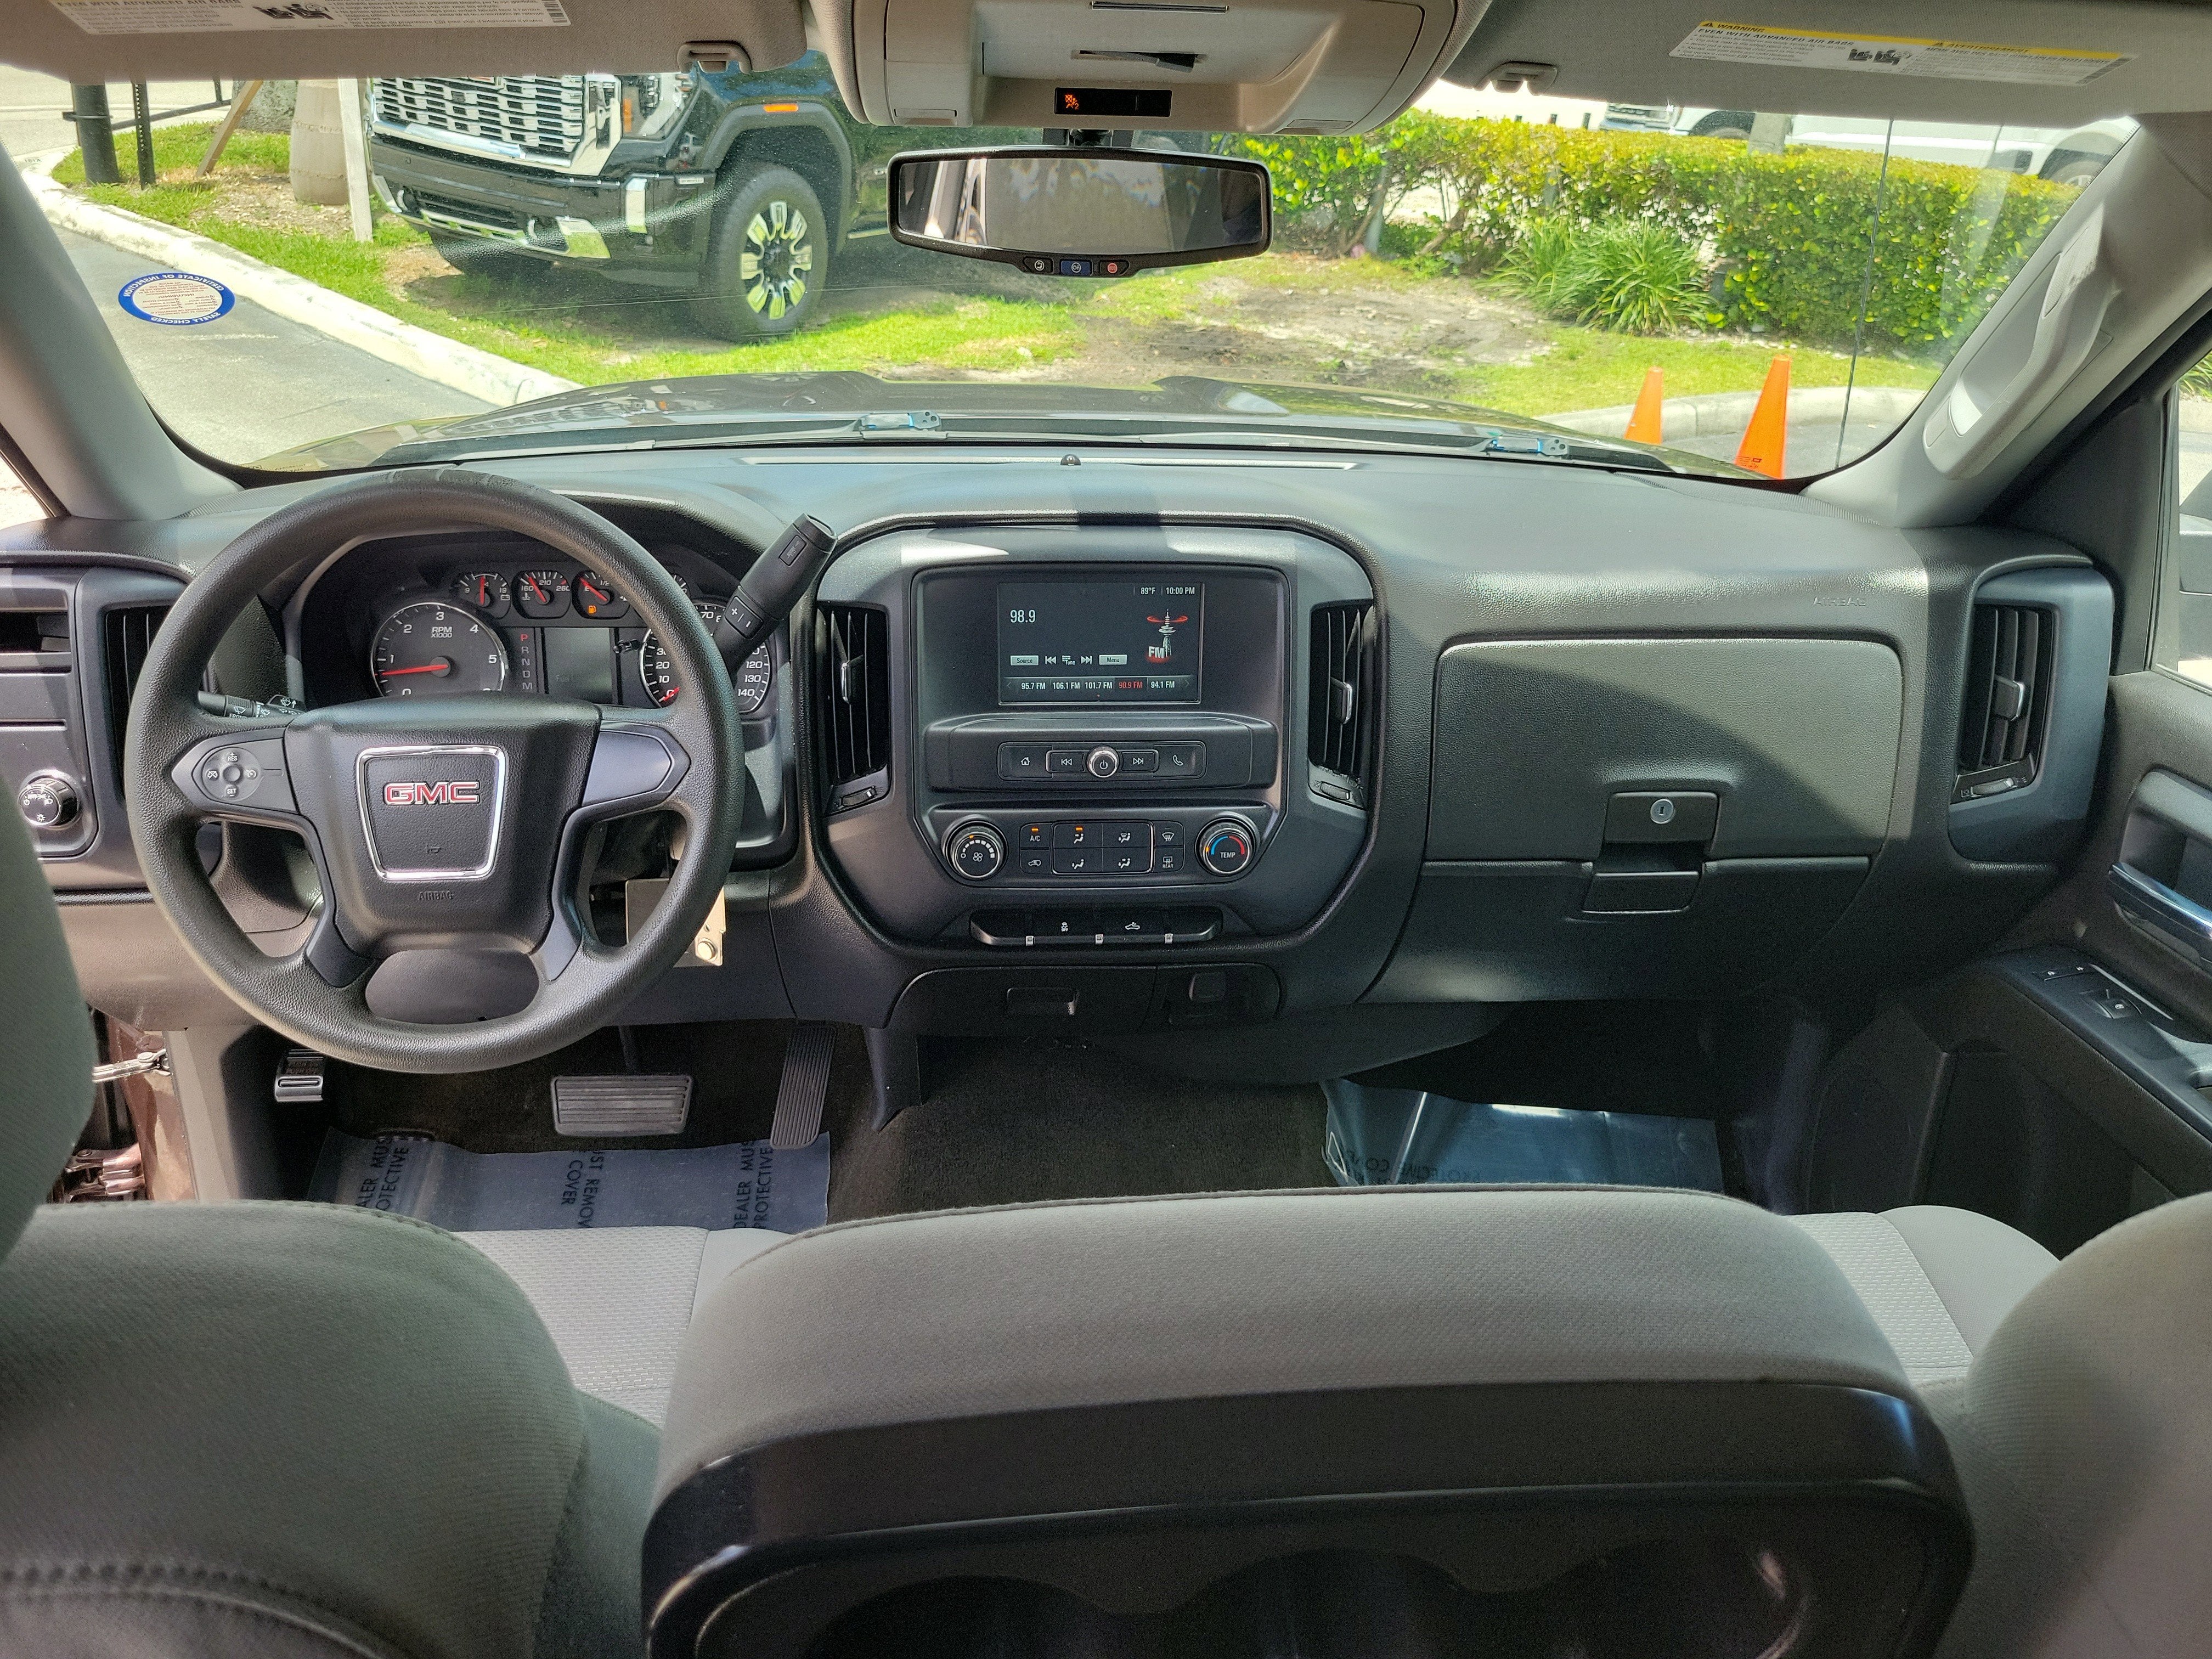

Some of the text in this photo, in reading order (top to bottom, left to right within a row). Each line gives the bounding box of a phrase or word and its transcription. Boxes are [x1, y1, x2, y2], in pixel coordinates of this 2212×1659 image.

[1717, 24, 1765, 33] WARNING
[1753, 33, 1805, 42] ADVANCED
[436, 612, 444, 620] 3
[1010, 610, 1036, 623] 98.9
[404, 624, 412, 633] 2
[470, 624, 478, 633] 4
[1148, 646, 1165, 658] FM
[390, 654, 394, 664] 1
[488, 654, 497, 664] 5
[385, 781, 480, 805] GMC
[1030, 834, 1040, 843] A/C
[419, 890, 454, 900] AIRBAG
[741, 1141, 754, 1171] MUS
[376, 1148, 409, 1211] OTECTIVE
[561, 1160, 583, 1205] COVER
[356, 1178, 379, 1207] ALER
[578, 1179, 600, 1228] REMOV
